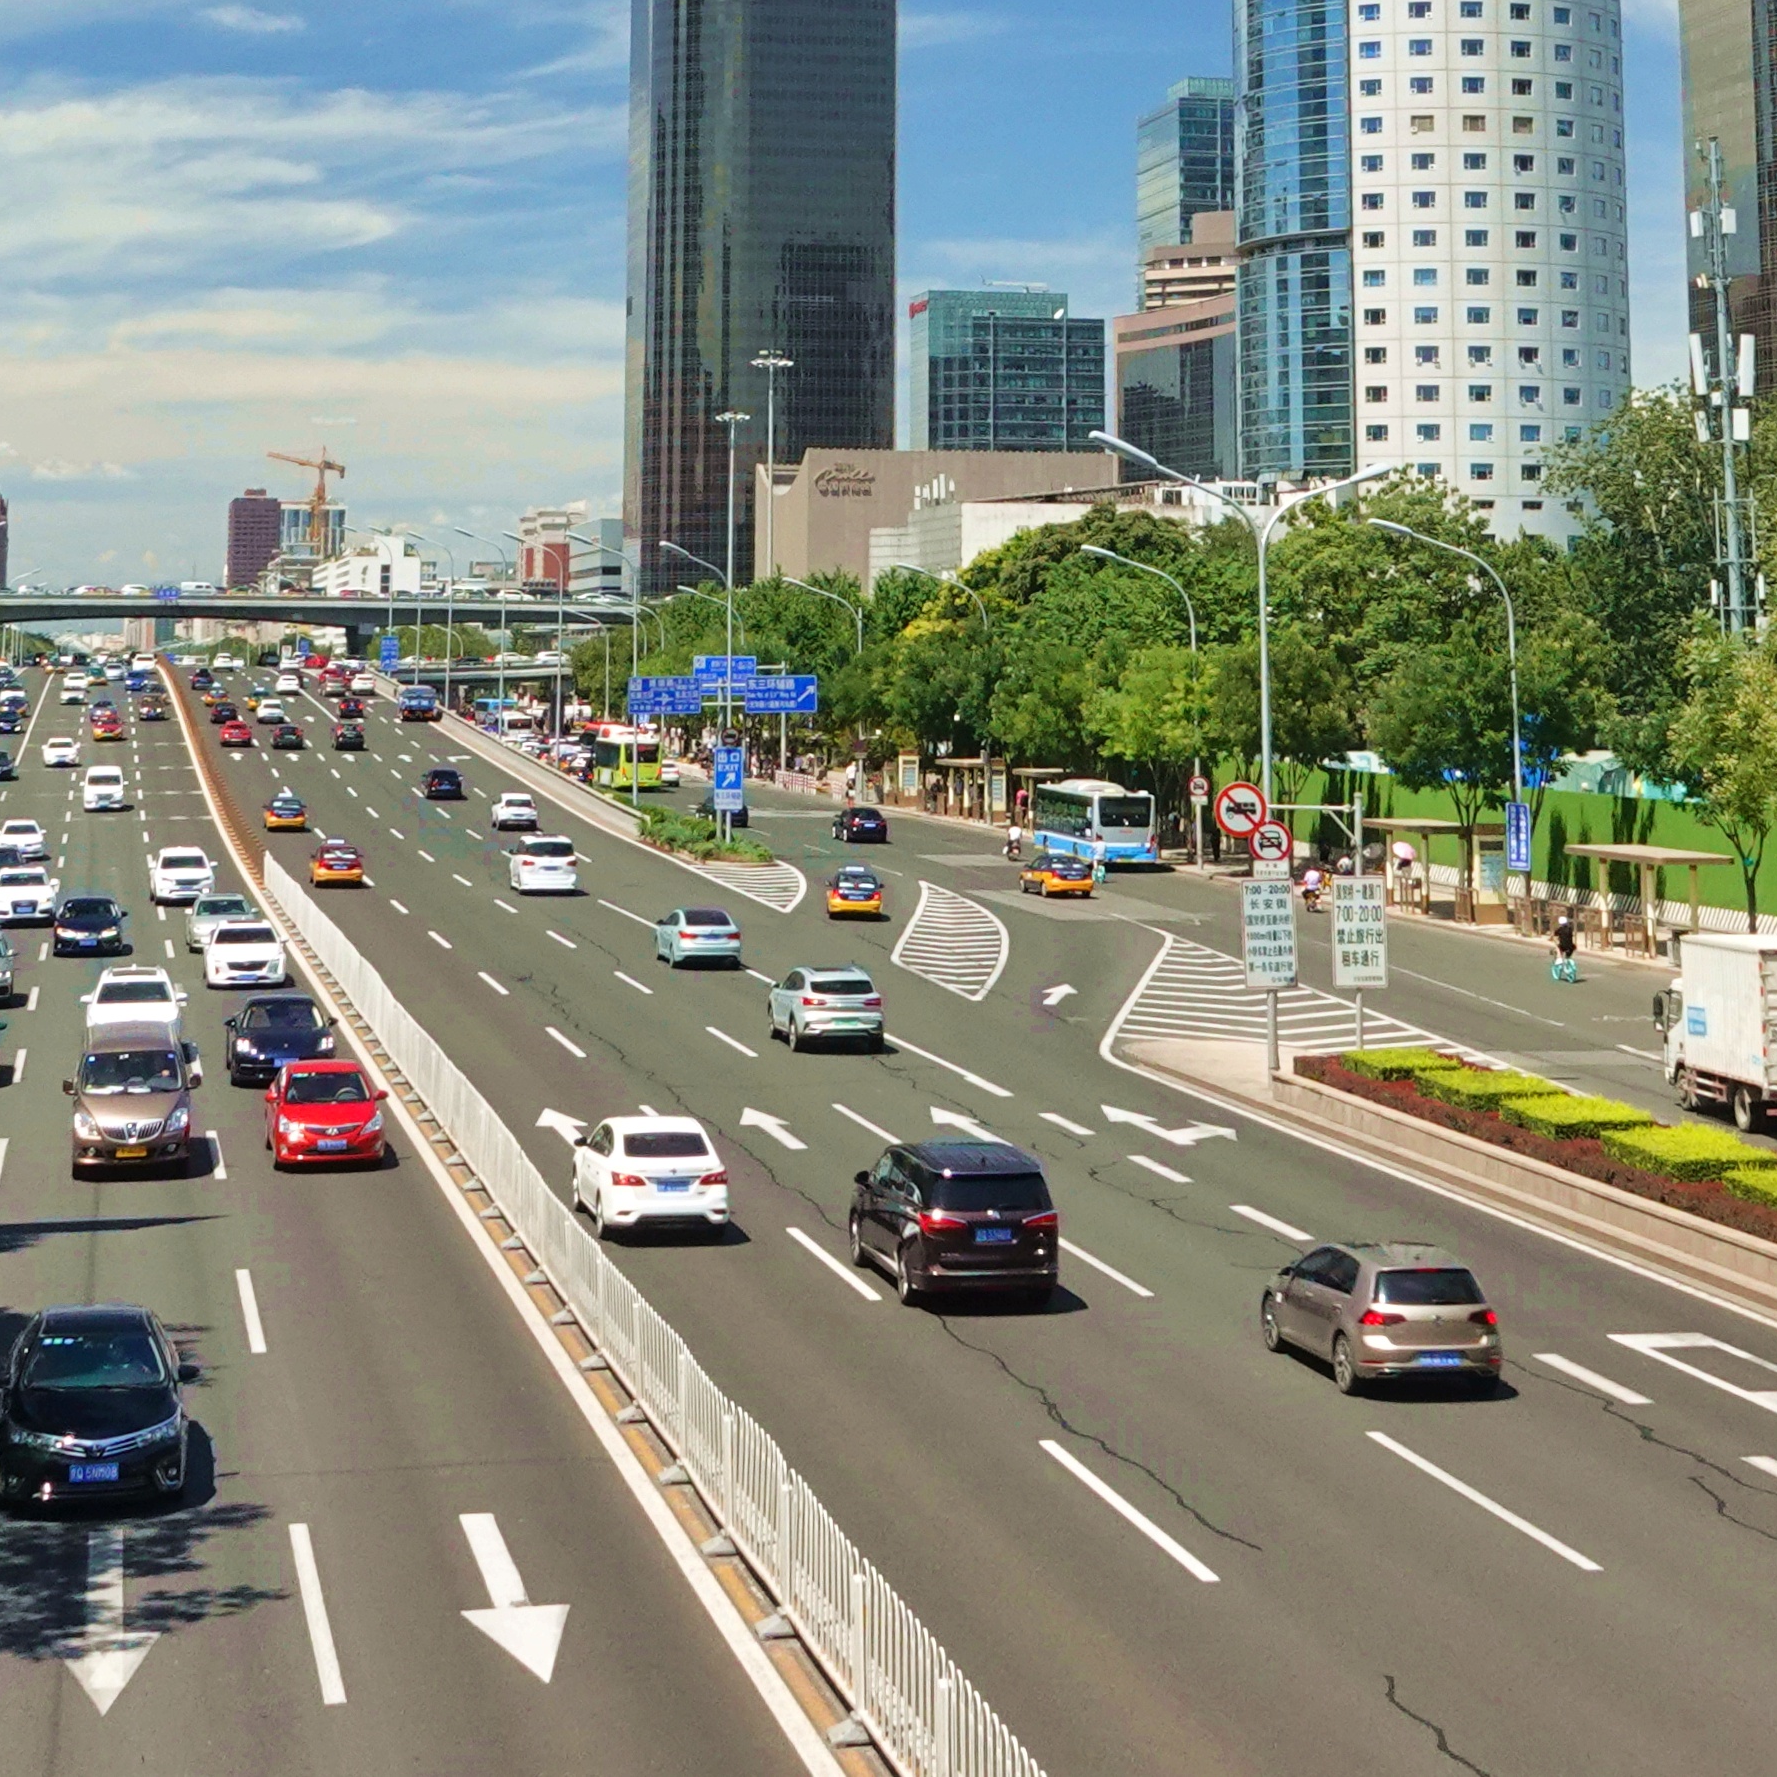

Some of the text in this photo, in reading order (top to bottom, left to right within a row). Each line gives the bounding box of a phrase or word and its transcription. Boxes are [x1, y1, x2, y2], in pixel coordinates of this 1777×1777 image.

[717, 751, 740, 763] 出口
[717, 763, 739, 772] EXIT
[1249, 898, 1287, 910] 长安街
